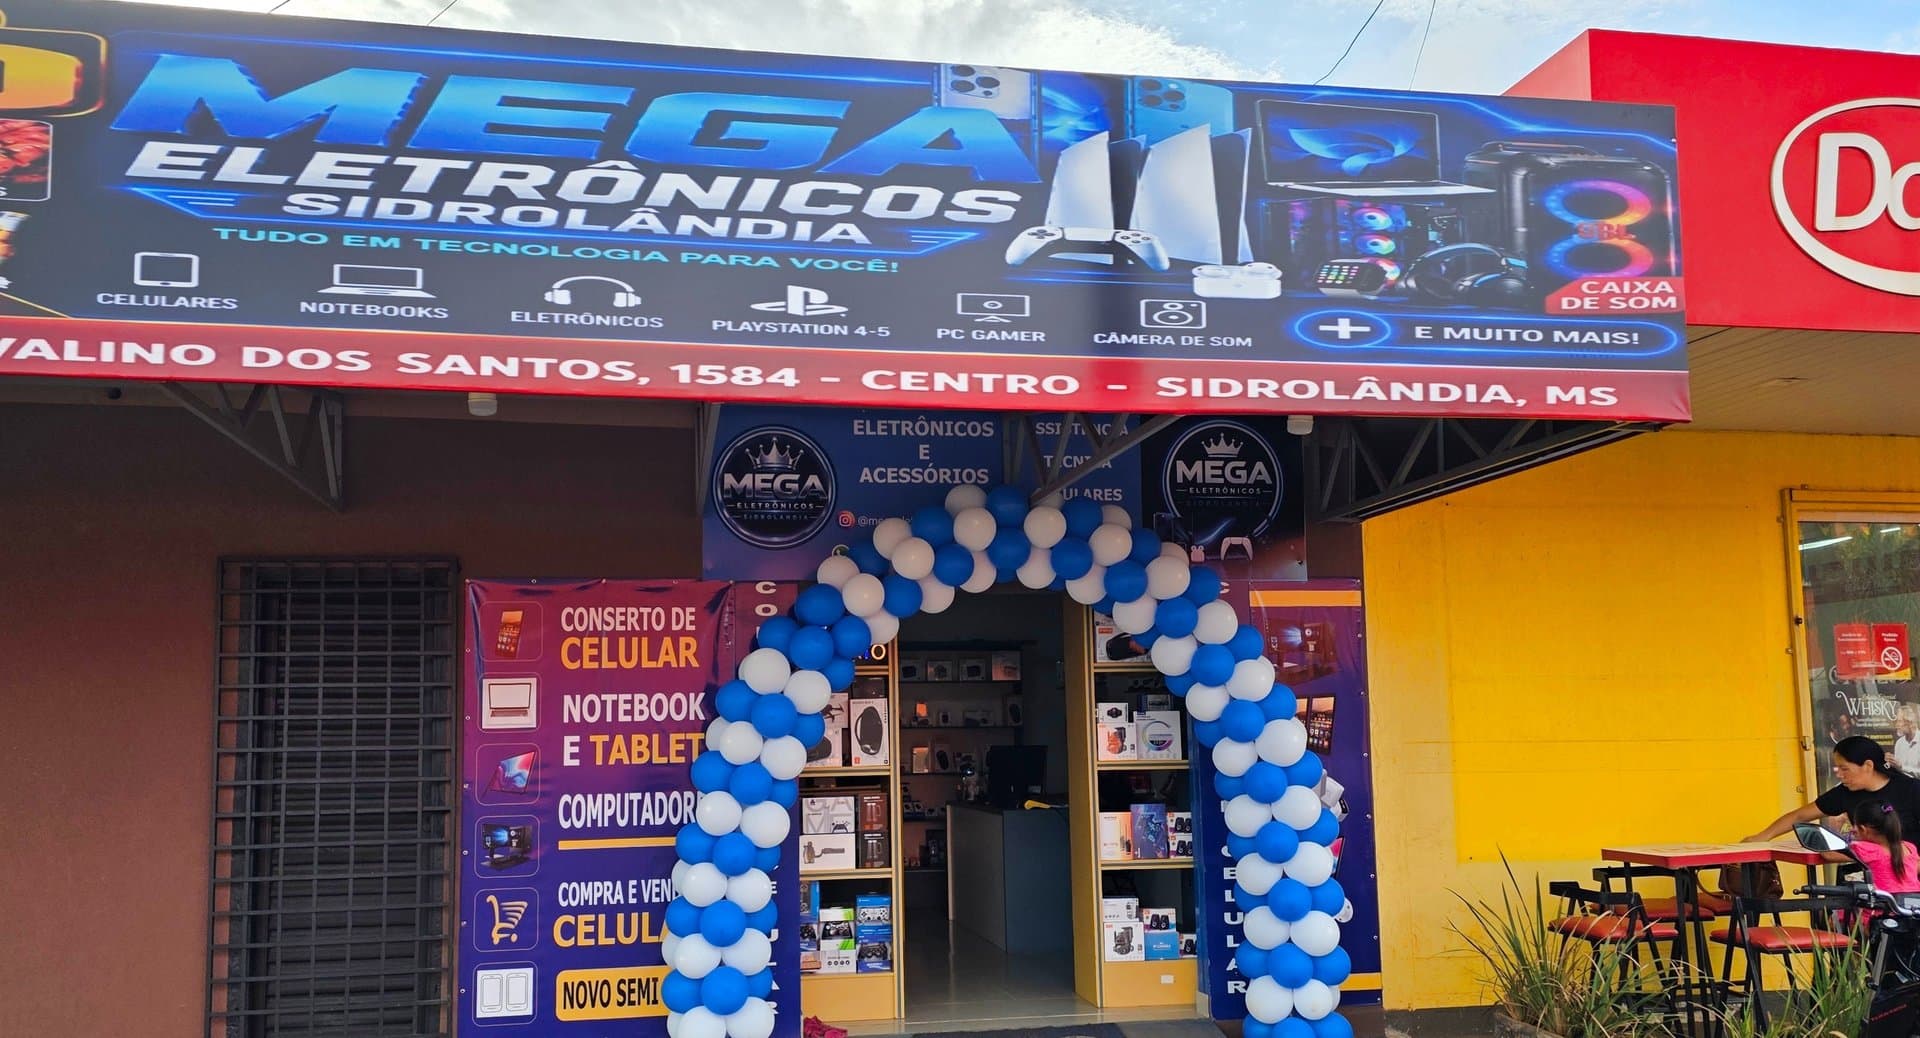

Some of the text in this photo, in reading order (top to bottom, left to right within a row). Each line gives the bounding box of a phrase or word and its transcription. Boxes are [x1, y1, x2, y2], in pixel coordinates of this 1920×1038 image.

[109, 53, 1042, 183] MEGA
[125, 141, 1022, 224] ELETRÔNICOS
[282, 193, 873, 246] SIDROLÂNDIA
[213, 228, 899, 273] TUDO EM TECNOLOGIA PARA VOCÊ!
[1581, 281, 1674, 294] CAIXA
[96, 292, 239, 311] CELULARES
[300, 301, 449, 320] NOTEBOOKS
[1561, 297, 1677, 310] DE SOM
[510, 308, 664, 329] ELETRÔNICOS
[712, 319, 891, 338] PLAYSTATION 4-5
[936, 328, 1046, 343] PC GAMER
[1093, 330, 1253, 347] CÂMERA DE SOM
[1415, 327, 1640, 346] E MUITO MAIS!
[242, 346, 371, 372] DOS
[396, 353, 650, 385] SANTOS,
[669, 363, 800, 388] 1584
[860, 371, 1079, 396] CENTRO
[1156, 377, 1527, 408] SIDROLÂNDIA,
[1545, 387, 1619, 406] MS
[853, 416, 994, 437] ELETRÔNICOS
[918, 444, 930, 460] E
[859, 463, 990, 485] ACESSÓRIOS
[1176, 460, 1273, 485] MEGA
[723, 473, 829, 499] MEGA
[1189, 487, 1261, 495] ELETRÔNICOS
[736, 502, 814, 510] ELETRÔNICOS
[561, 607, 696, 632] CONSERTO DE
[560, 636, 700, 670] CELULAR
[563, 692, 706, 723] NOTEBOOK
[1835, 691, 1898, 721] WHISKY
[563, 732, 705, 767] E TABLET
[558, 881, 624, 907] COMPRA
[628, 881, 638, 904] E
[563, 977, 659, 1010] NOVO SEMI
